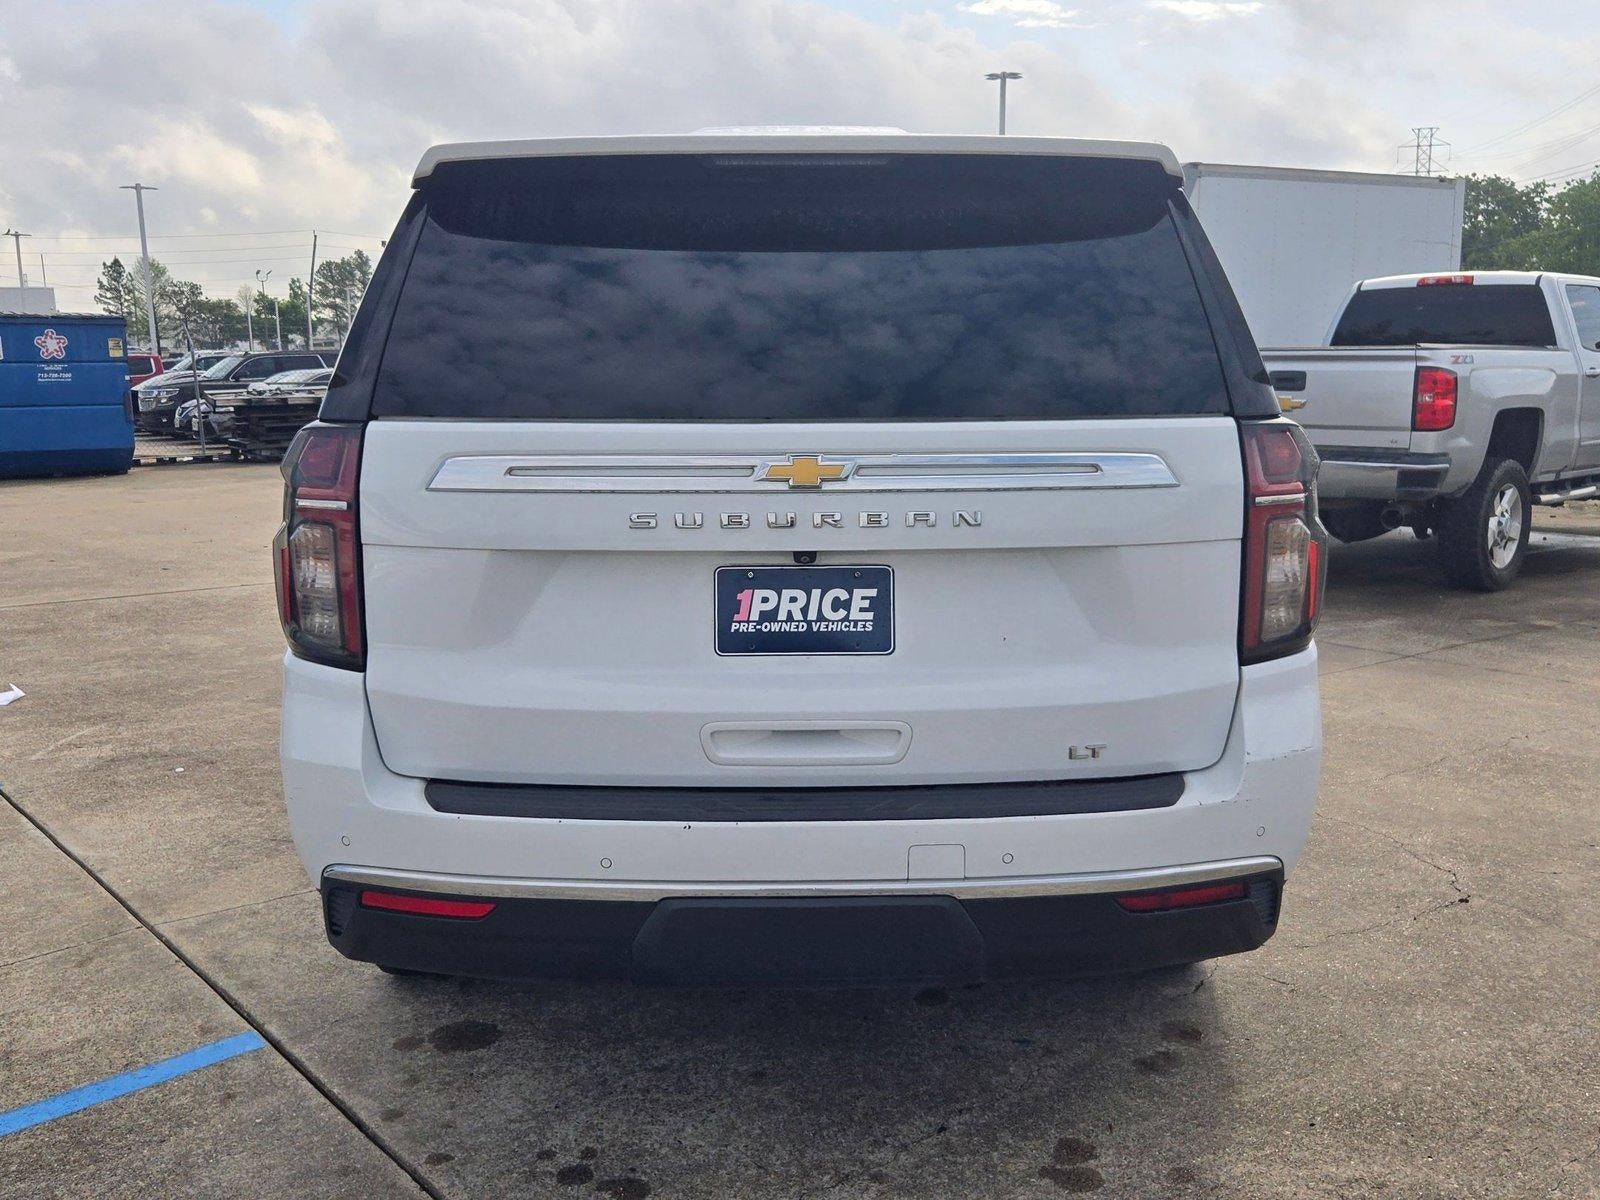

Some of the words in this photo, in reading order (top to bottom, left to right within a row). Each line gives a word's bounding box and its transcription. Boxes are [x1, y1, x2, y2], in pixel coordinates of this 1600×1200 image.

[628, 511, 983, 529] SUBURBAN
[732, 588, 878, 621] 1PRICE
[730, 621, 807, 633] PRE-OWNED
[812, 621, 873, 632] VEHICLES
[1068, 744, 1107, 760] LT
